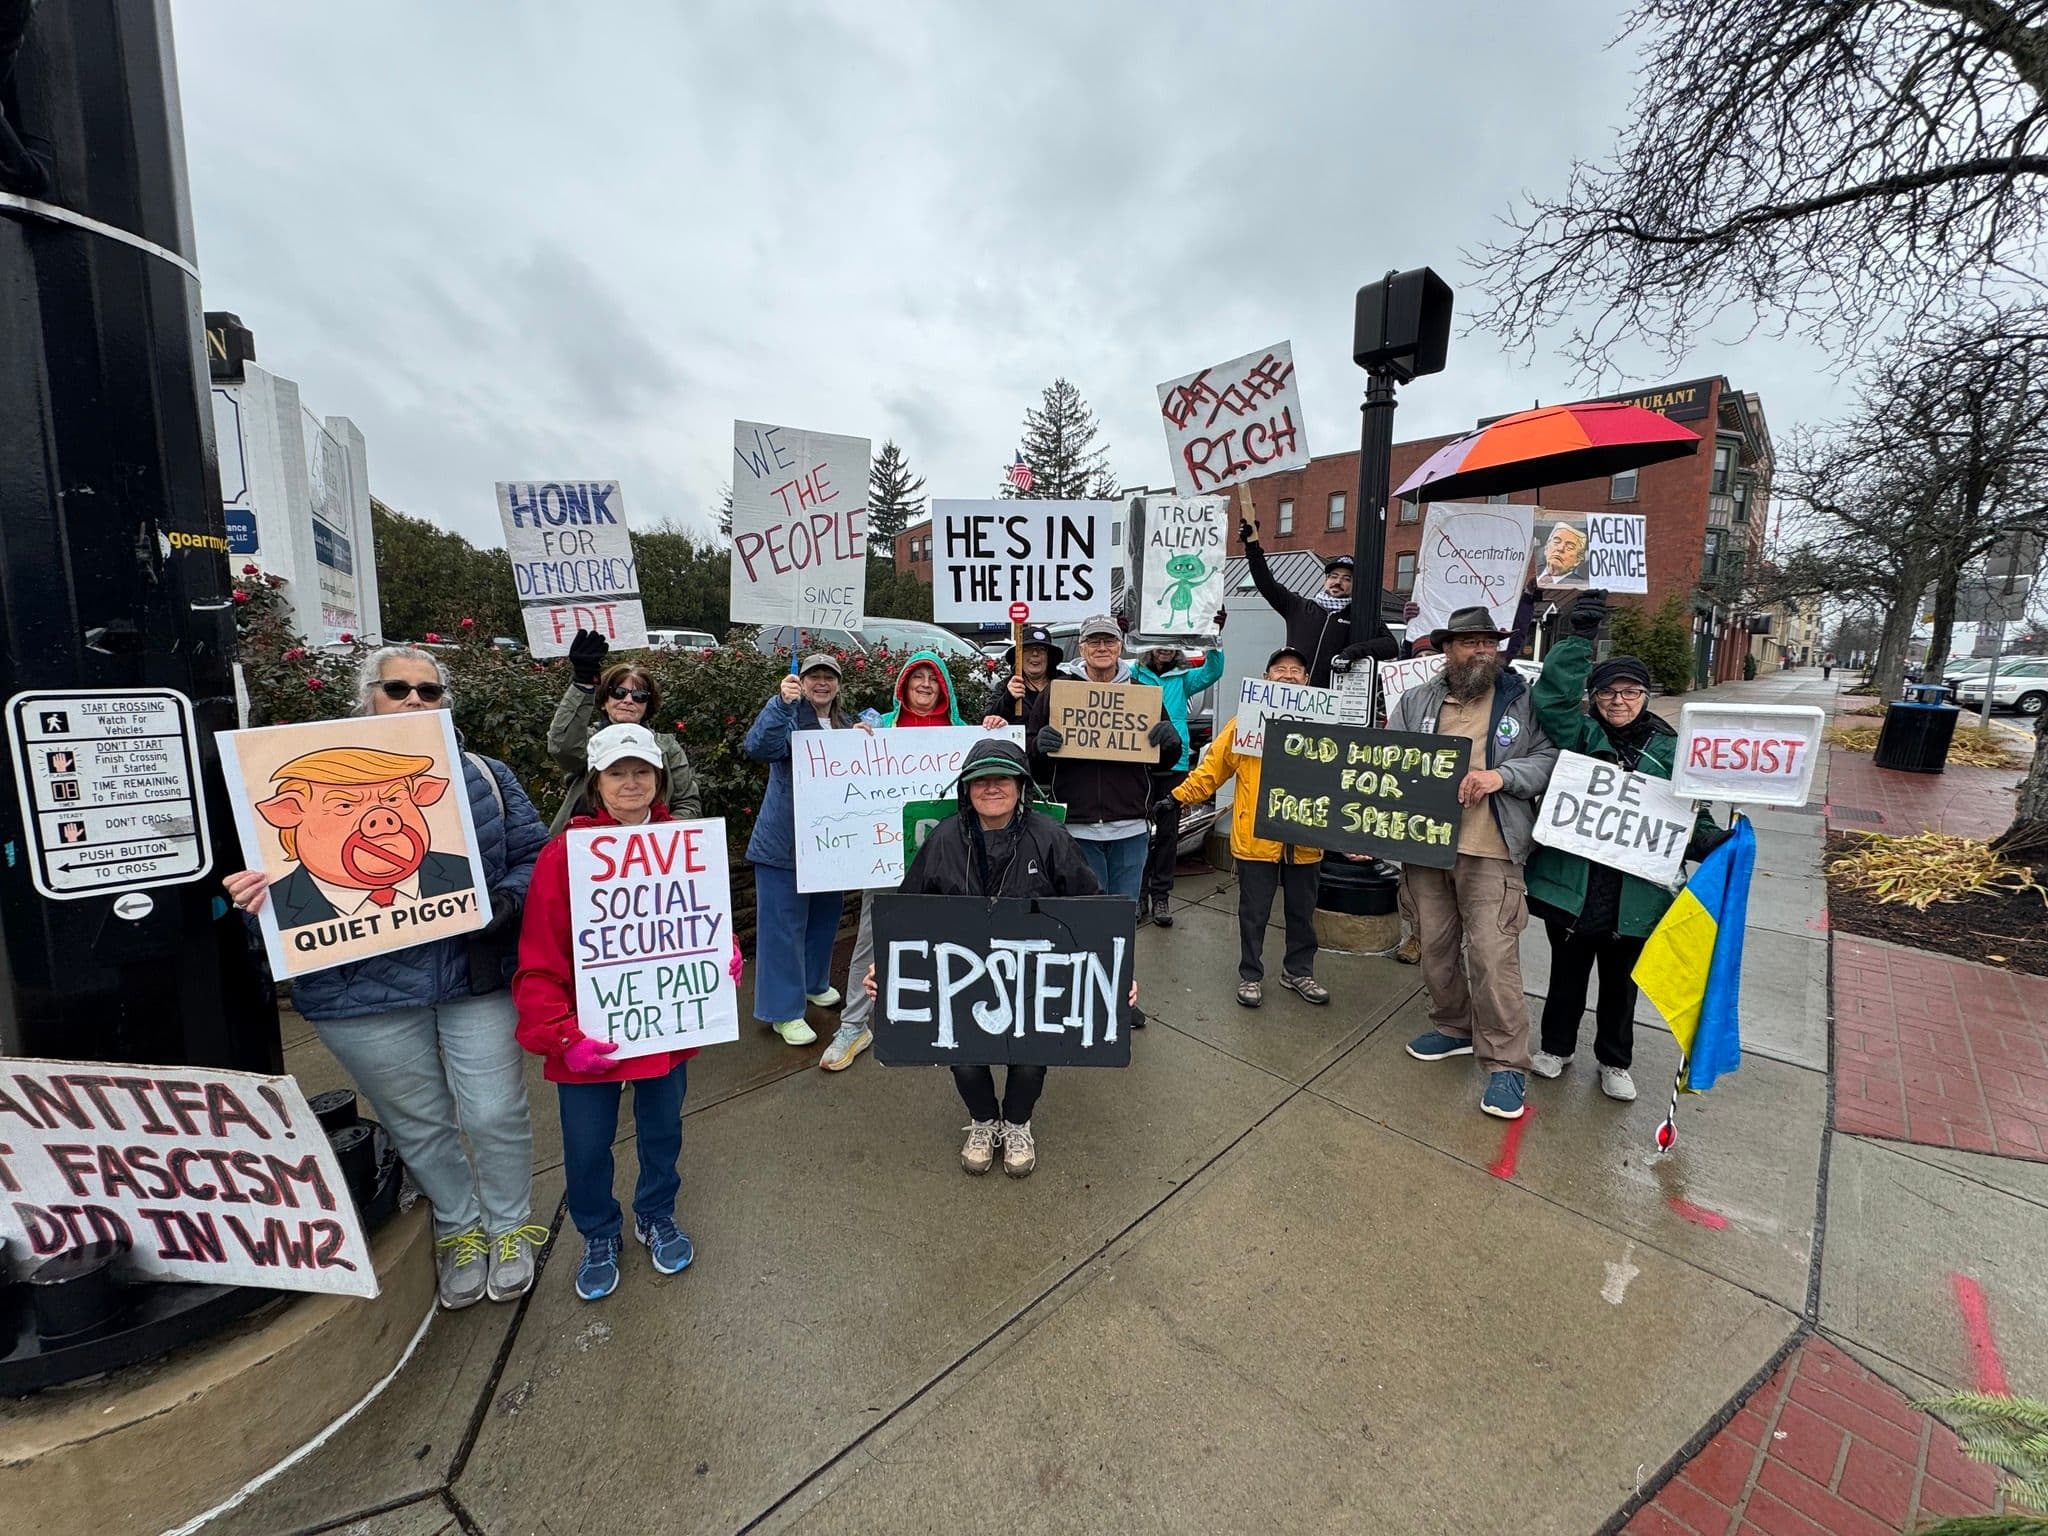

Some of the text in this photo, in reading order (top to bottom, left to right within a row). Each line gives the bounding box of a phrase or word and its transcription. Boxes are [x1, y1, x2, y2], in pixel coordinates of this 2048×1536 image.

[1162, 353, 1294, 430] EAT THE
[734, 427, 796, 480] WE
[1183, 405, 1296, 490] RICH
[508, 483, 618, 529] HONK
[770, 462, 840, 517] THE
[1158, 504, 1215, 525] TRUE
[1590, 517, 1645, 545] AGENT
[543, 529, 597, 556] FOR
[735, 507, 868, 584] PEOPLE
[946, 515, 1095, 560] HE'S IN
[1151, 525, 1220, 550] ALIENS
[1437, 534, 1526, 562] Concentration
[513, 557, 635, 597] DEMOCRACY
[1445, 564, 1505, 598] Camps
[1589, 550, 1647, 578] ORANGE
[803, 586, 856, 606] SINCE
[948, 564, 1095, 602] THE FILES
[550, 603, 618, 644] FDT
[808, 606, 858, 629] 1776
[81, 702, 165, 712] START CROSSING
[1089, 690, 1125, 708] DUE
[1241, 680, 1339, 715] HEALTHCARE
[98, 715, 147, 725] Watch For
[105, 726, 144, 735] Vehicles
[1063, 707, 1149, 730] PROCESS
[96, 740, 163, 752] DON'T START
[1065, 727, 1141, 751] FOR ALL
[1283, 733, 1459, 778] OLD HIPPIE
[1690, 736, 1805, 774] RESIST
[95, 753, 168, 765] Finish Crossing
[112, 763, 157, 774] If Started
[806, 738, 962, 778] Healthcare
[92, 776, 179, 791] TIME REMAINING
[92, 788, 181, 803] To Finish Crossing
[1340, 768, 1403, 798] FOR
[1587, 765, 1647, 807] BE
[105, 813, 173, 829] DON'T CROSS
[1268, 788, 1452, 846] FREE SPEECH
[1551, 791, 1687, 858] DECENT
[80, 843, 167, 861] PUSH BUTTON
[589, 829, 706, 882] SAVE
[816, 828, 858, 851] NOT
[95, 862, 157, 878] TO CROSS
[590, 879, 710, 924] SOCIAL
[294, 894, 479, 953] QUIET PIGGY!
[579, 912, 723, 963] SECURITY
[590, 961, 720, 1009] WE PAID
[886, 937, 1126, 1049] EPSTEIN
[607, 998, 710, 1044] FOR IT
[43, 1144, 337, 1212] FASCISM
[12, 1203, 358, 1273] DID IN WW2
